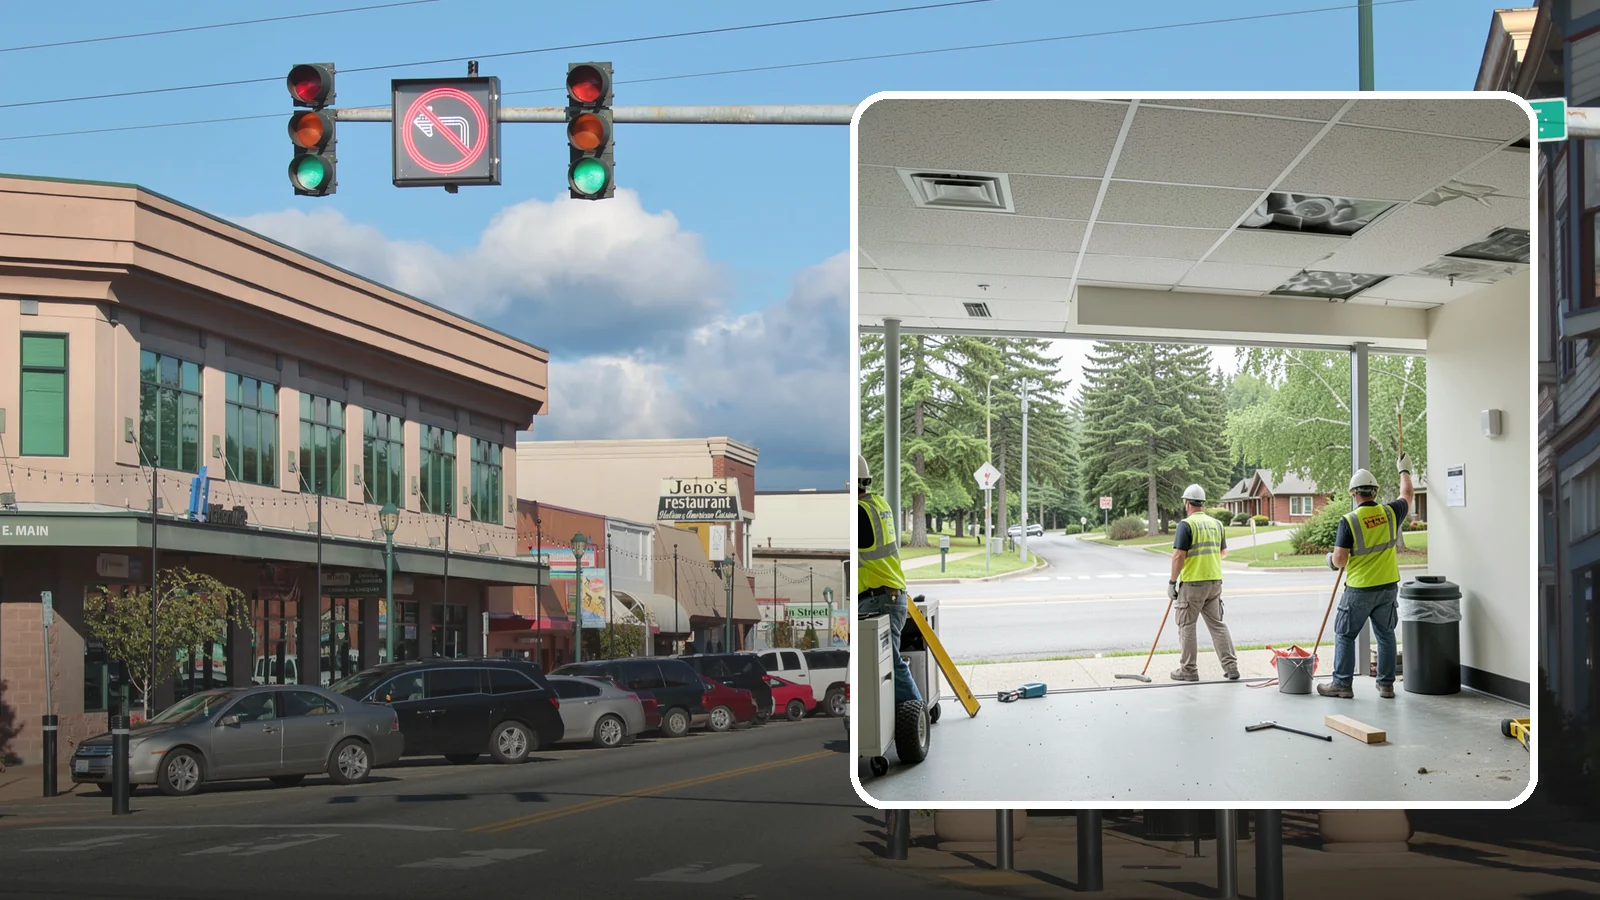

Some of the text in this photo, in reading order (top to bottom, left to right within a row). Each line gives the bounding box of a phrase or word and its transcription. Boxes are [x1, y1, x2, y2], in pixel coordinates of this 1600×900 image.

[670, 480, 727, 494] Jeno's
[665, 496, 731, 509] restaurant
[659, 510, 681, 519] Italian
[686, 509, 714, 519] American
[714, 509, 737, 519] Cuisine
[2, 525, 49, 536] E. MAIN
[797, 608, 829, 617] Street
